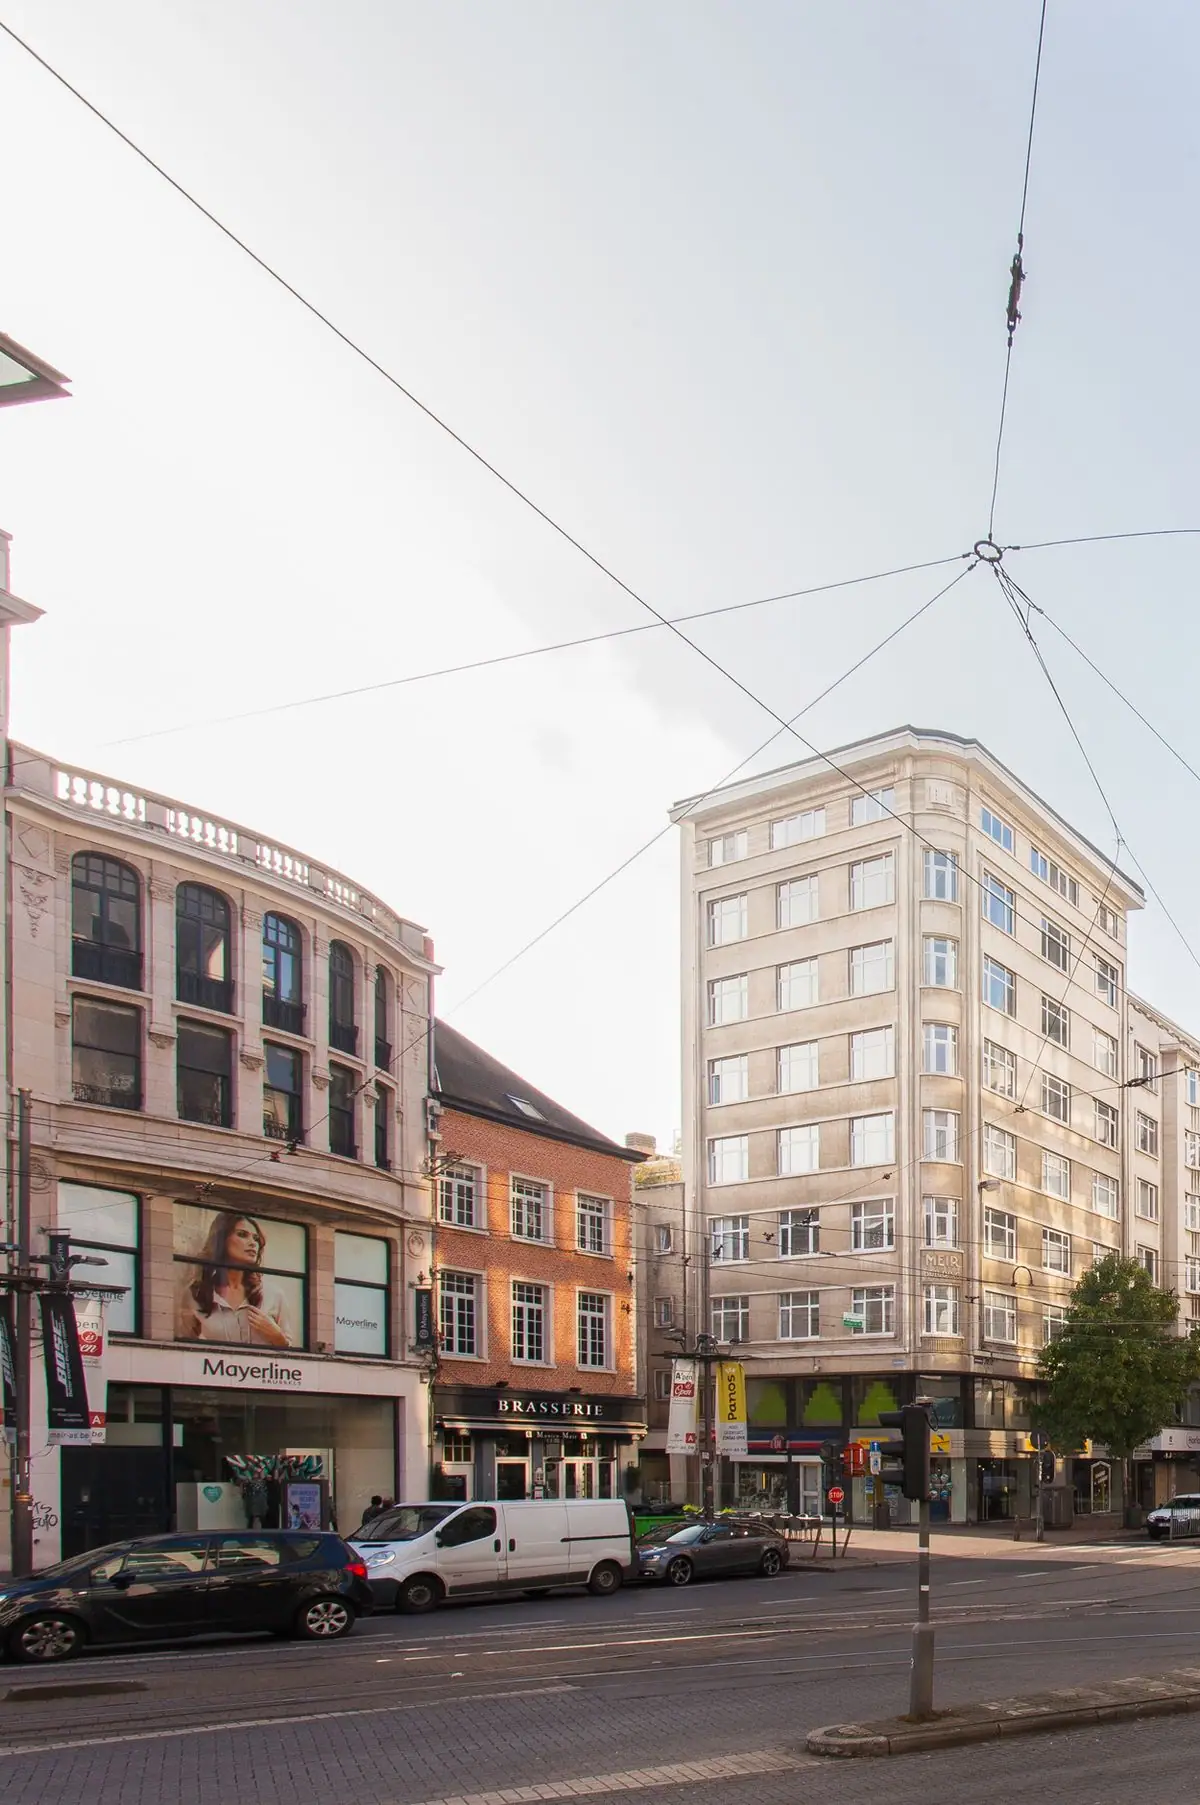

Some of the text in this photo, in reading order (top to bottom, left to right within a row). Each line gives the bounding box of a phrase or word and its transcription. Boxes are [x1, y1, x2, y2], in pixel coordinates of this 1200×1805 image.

[925, 1254, 960, 1268] MEIR
[420, 1294, 428, 1329] Mayerline
[336, 1316, 378, 1330] Mayerline
[52, 1316, 68, 1388] BOSE
[203, 1359, 302, 1382] Mayerline
[727, 1374, 737, 1420] Panos
[498, 1399, 604, 1417] BRASSERIE
[92, 1415, 102, 1425] A
[828, 1491, 844, 1499] STOP
